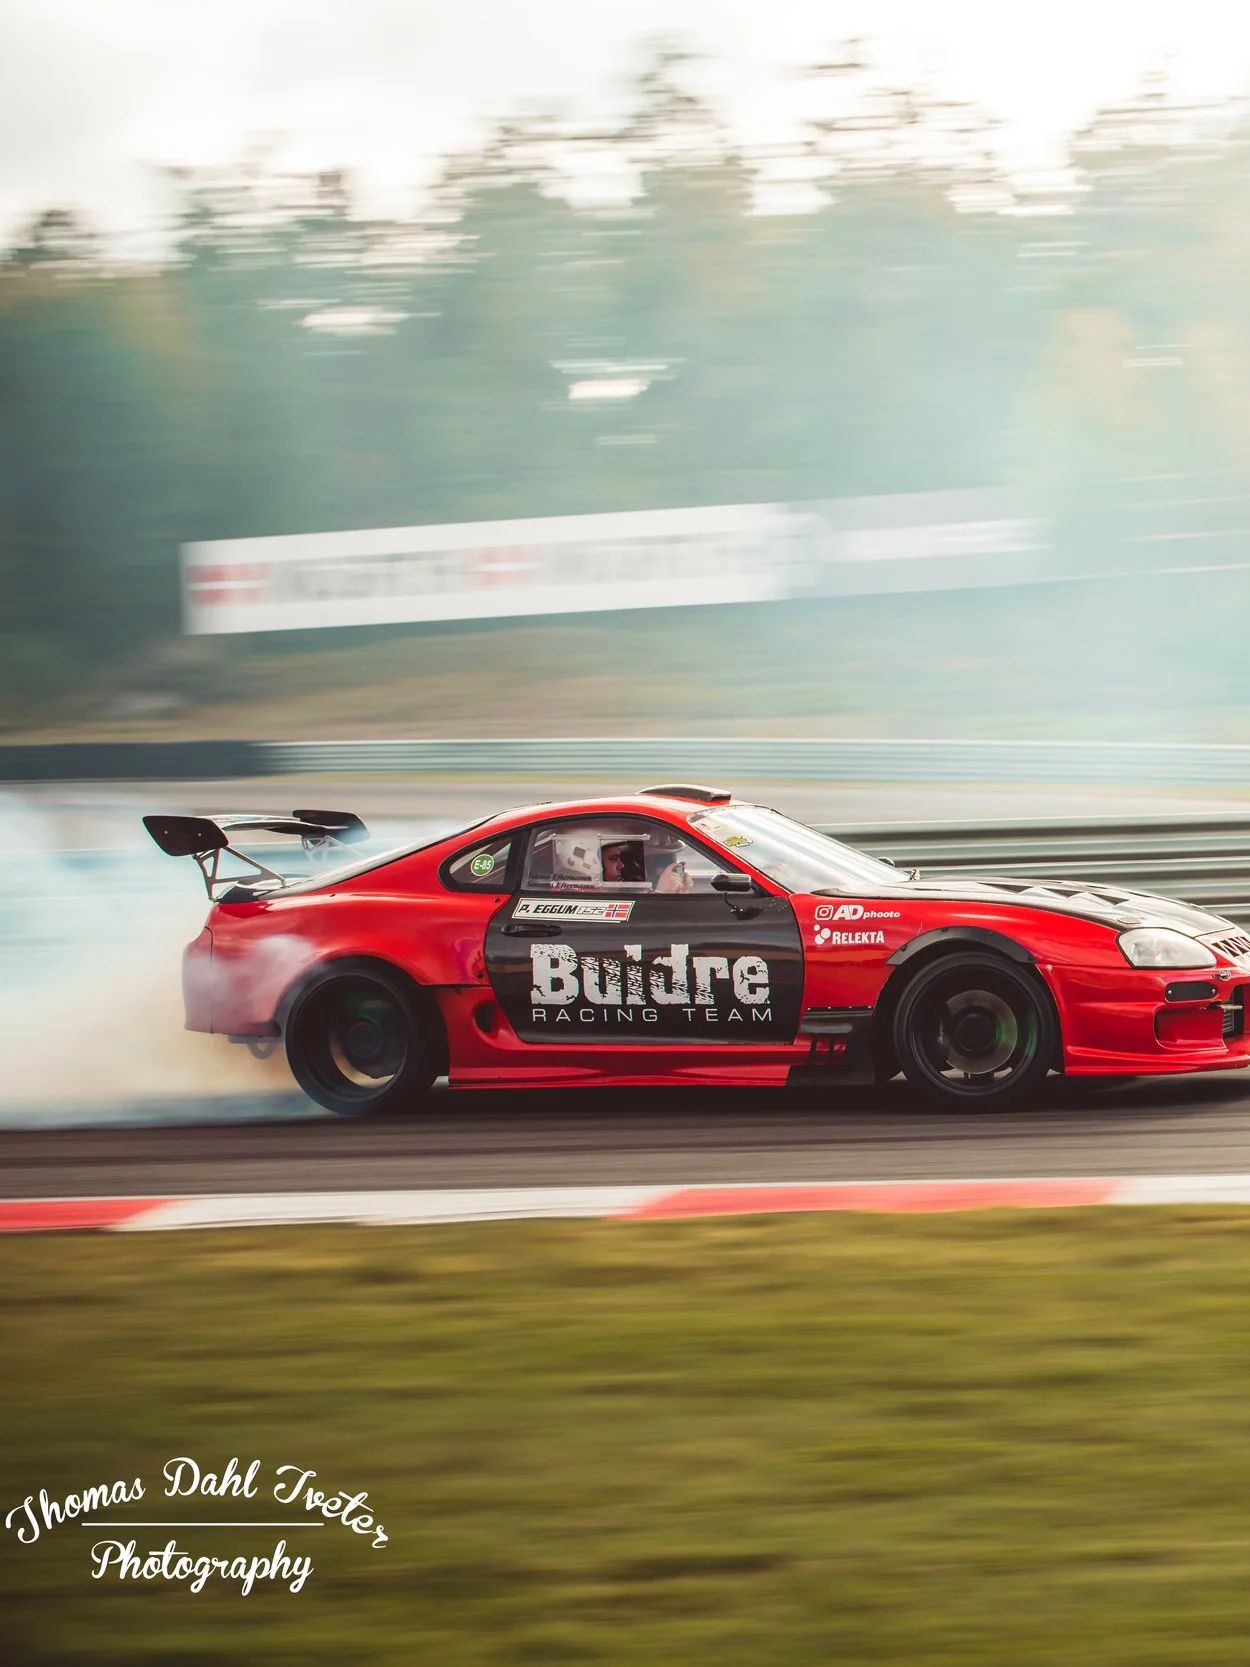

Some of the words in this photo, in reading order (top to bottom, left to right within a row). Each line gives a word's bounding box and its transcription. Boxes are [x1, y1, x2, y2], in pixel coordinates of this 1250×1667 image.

[474, 860, 492, 870] E-85
[518, 904, 531, 913] P.
[533, 904, 578, 915] EGGUM
[832, 931, 885, 945] RELEKTA
[530, 943, 771, 1005] Buldre
[532, 1008, 659, 1022] RACING
[682, 1008, 773, 1022] TEAM
